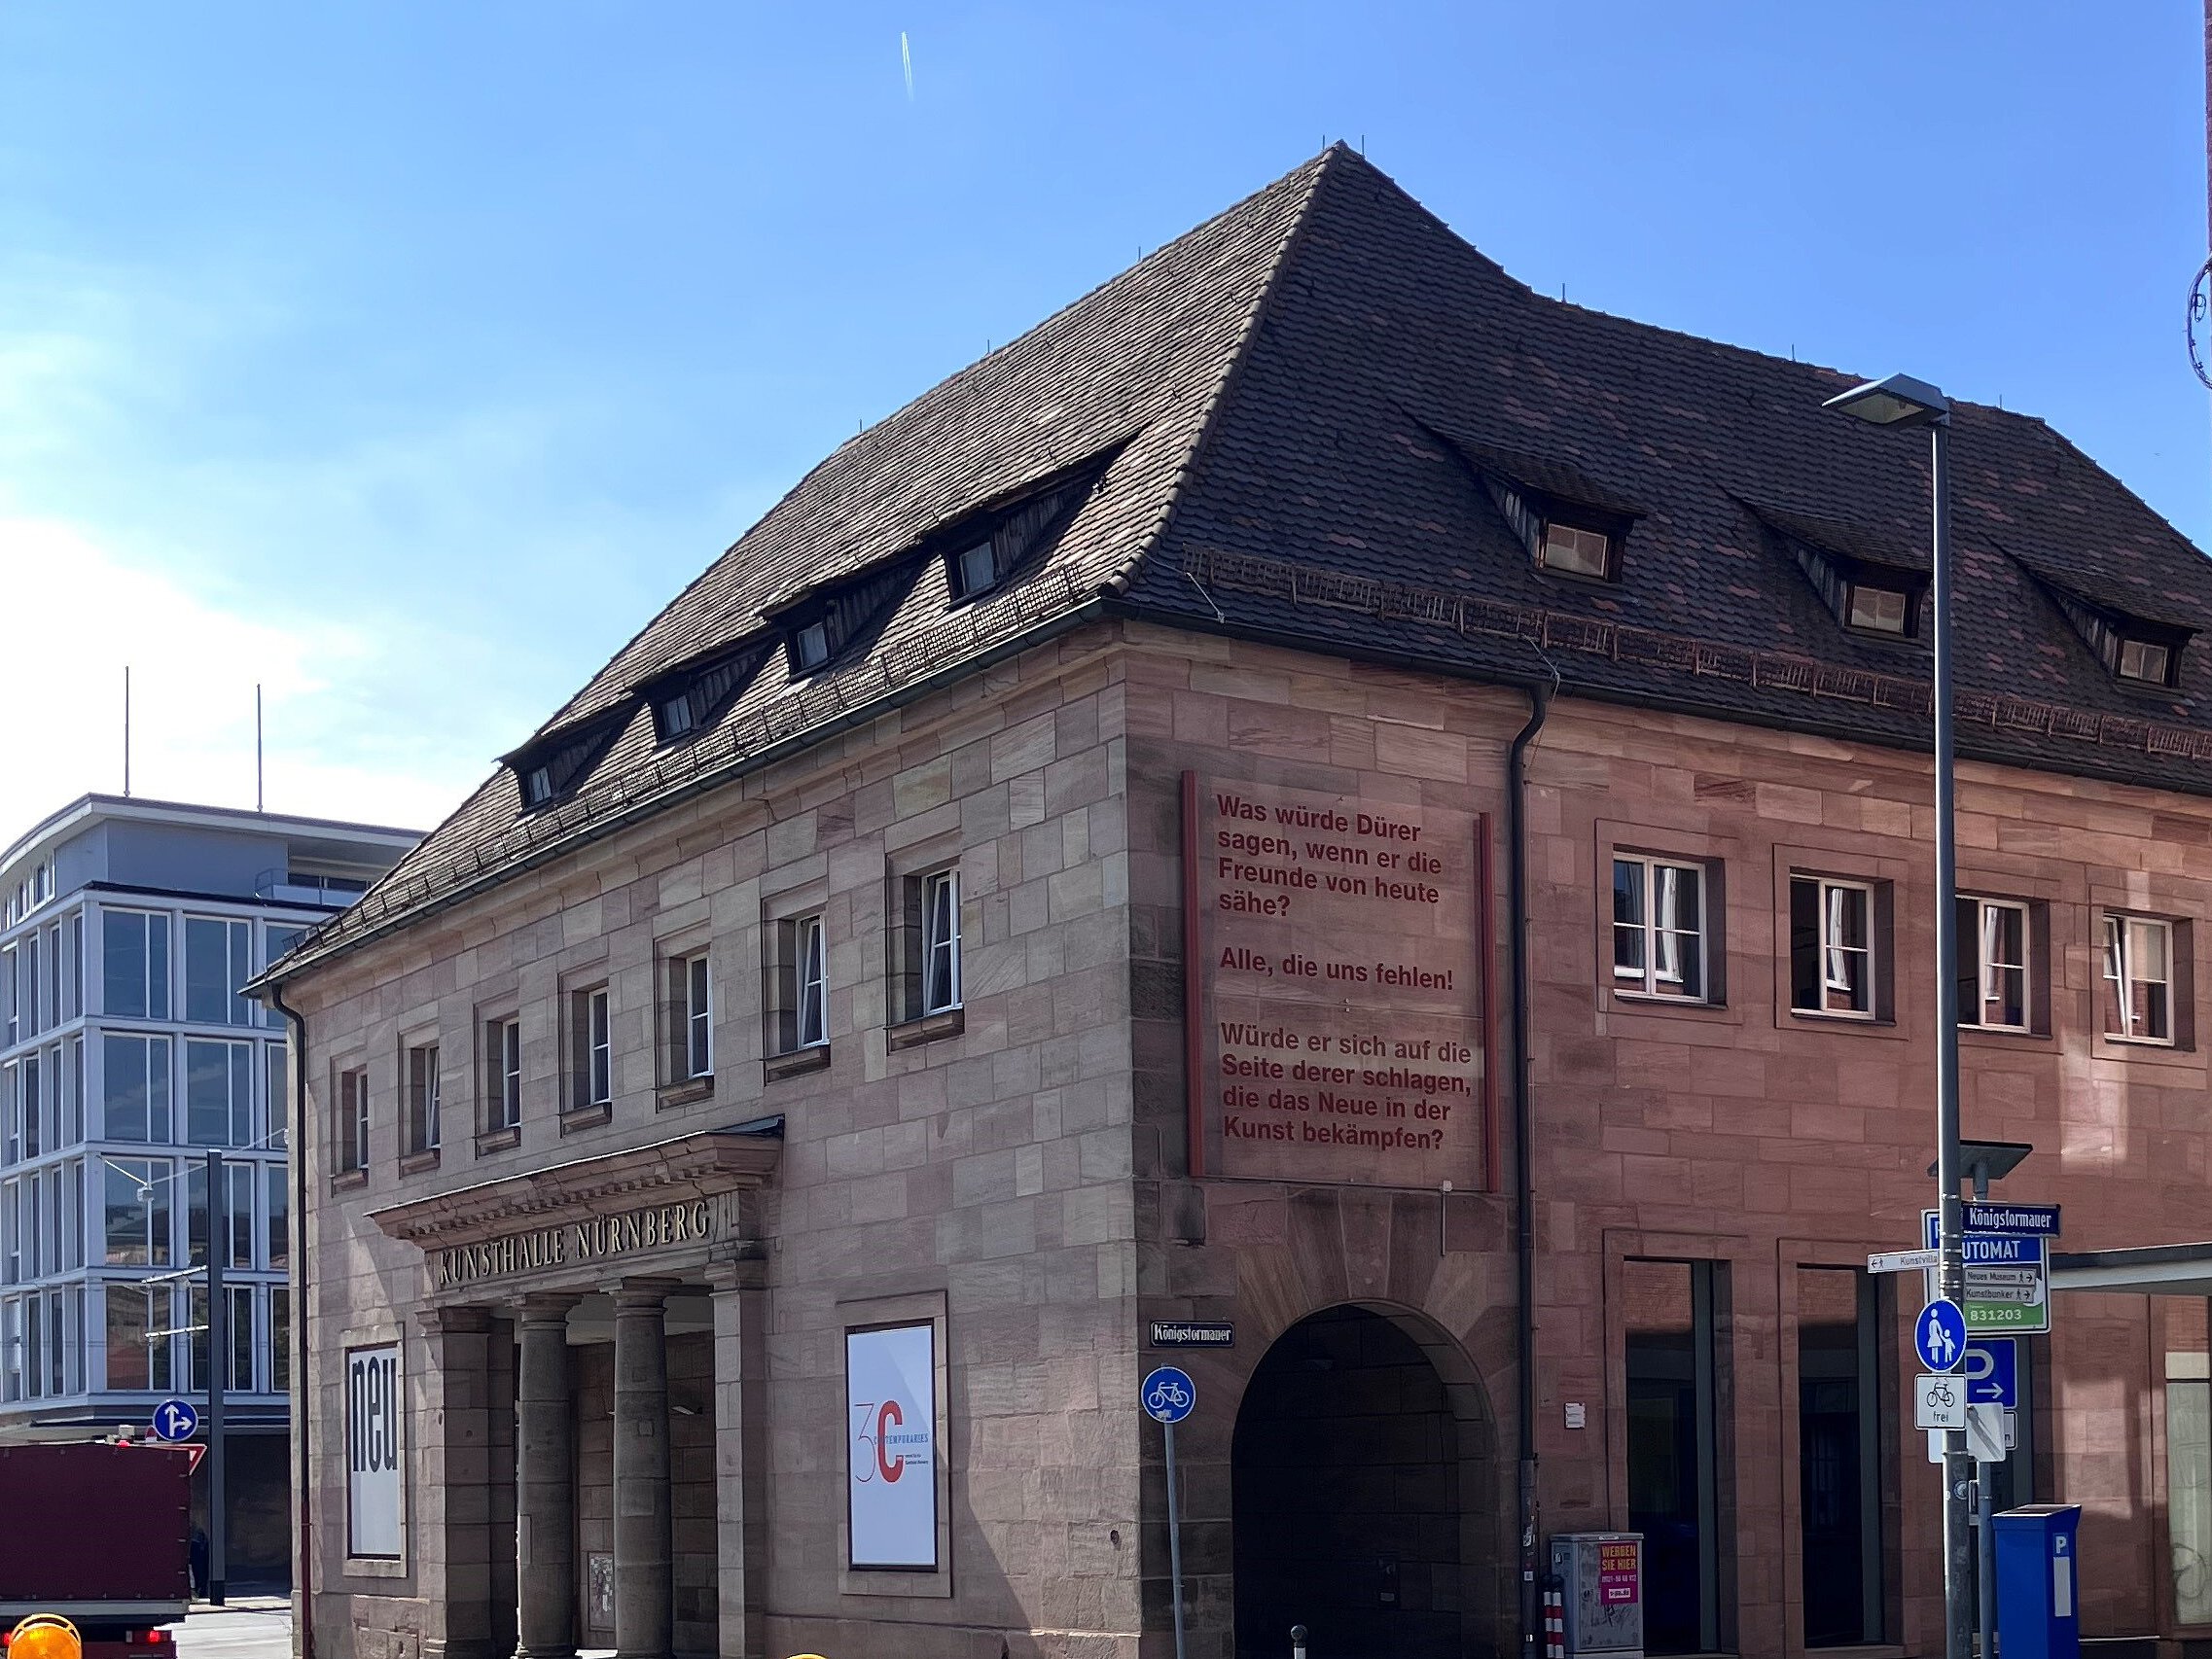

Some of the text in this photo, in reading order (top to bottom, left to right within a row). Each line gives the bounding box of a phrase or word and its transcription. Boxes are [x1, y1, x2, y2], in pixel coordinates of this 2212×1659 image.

[1218, 794, 1421, 841] Was würde Dürer
[1218, 830, 1442, 874] sagen, wenn er die
[1219, 858, 1439, 903] Freunde von heute
[1219, 893, 1290, 916] sähe?
[1221, 947, 1453, 990] Alle, die uns fehlen!
[1222, 1023, 1471, 1063] Würde er sich auf die
[1222, 1054, 1472, 1096] Seite derer schlagen,
[1224, 1086, 1451, 1120] die das Neue in der
[1224, 1117, 1444, 1150] Kunst bekämpfen?
[1970, 1208, 2051, 1229] Königstormauer
[439, 1202, 709, 1285] KUNSTHALLE NÜRNBERG
[1962, 1241, 2020, 1259] UTOMAT
[1900, 1253, 1937, 1265] Kunstvilla
[1967, 1288, 2014, 1298] Kunstbunker
[1970, 1309, 2022, 1321] 831203
[1154, 1324, 1231, 1342] Königstormauer
[351, 1356, 398, 1473] neu
[1934, 1411, 1950, 1422] frei
[1602, 1545, 1636, 1558] WERBEN
[2055, 1535, 2067, 1554] P
[1602, 1558, 1636, 1571] SIE HIER
